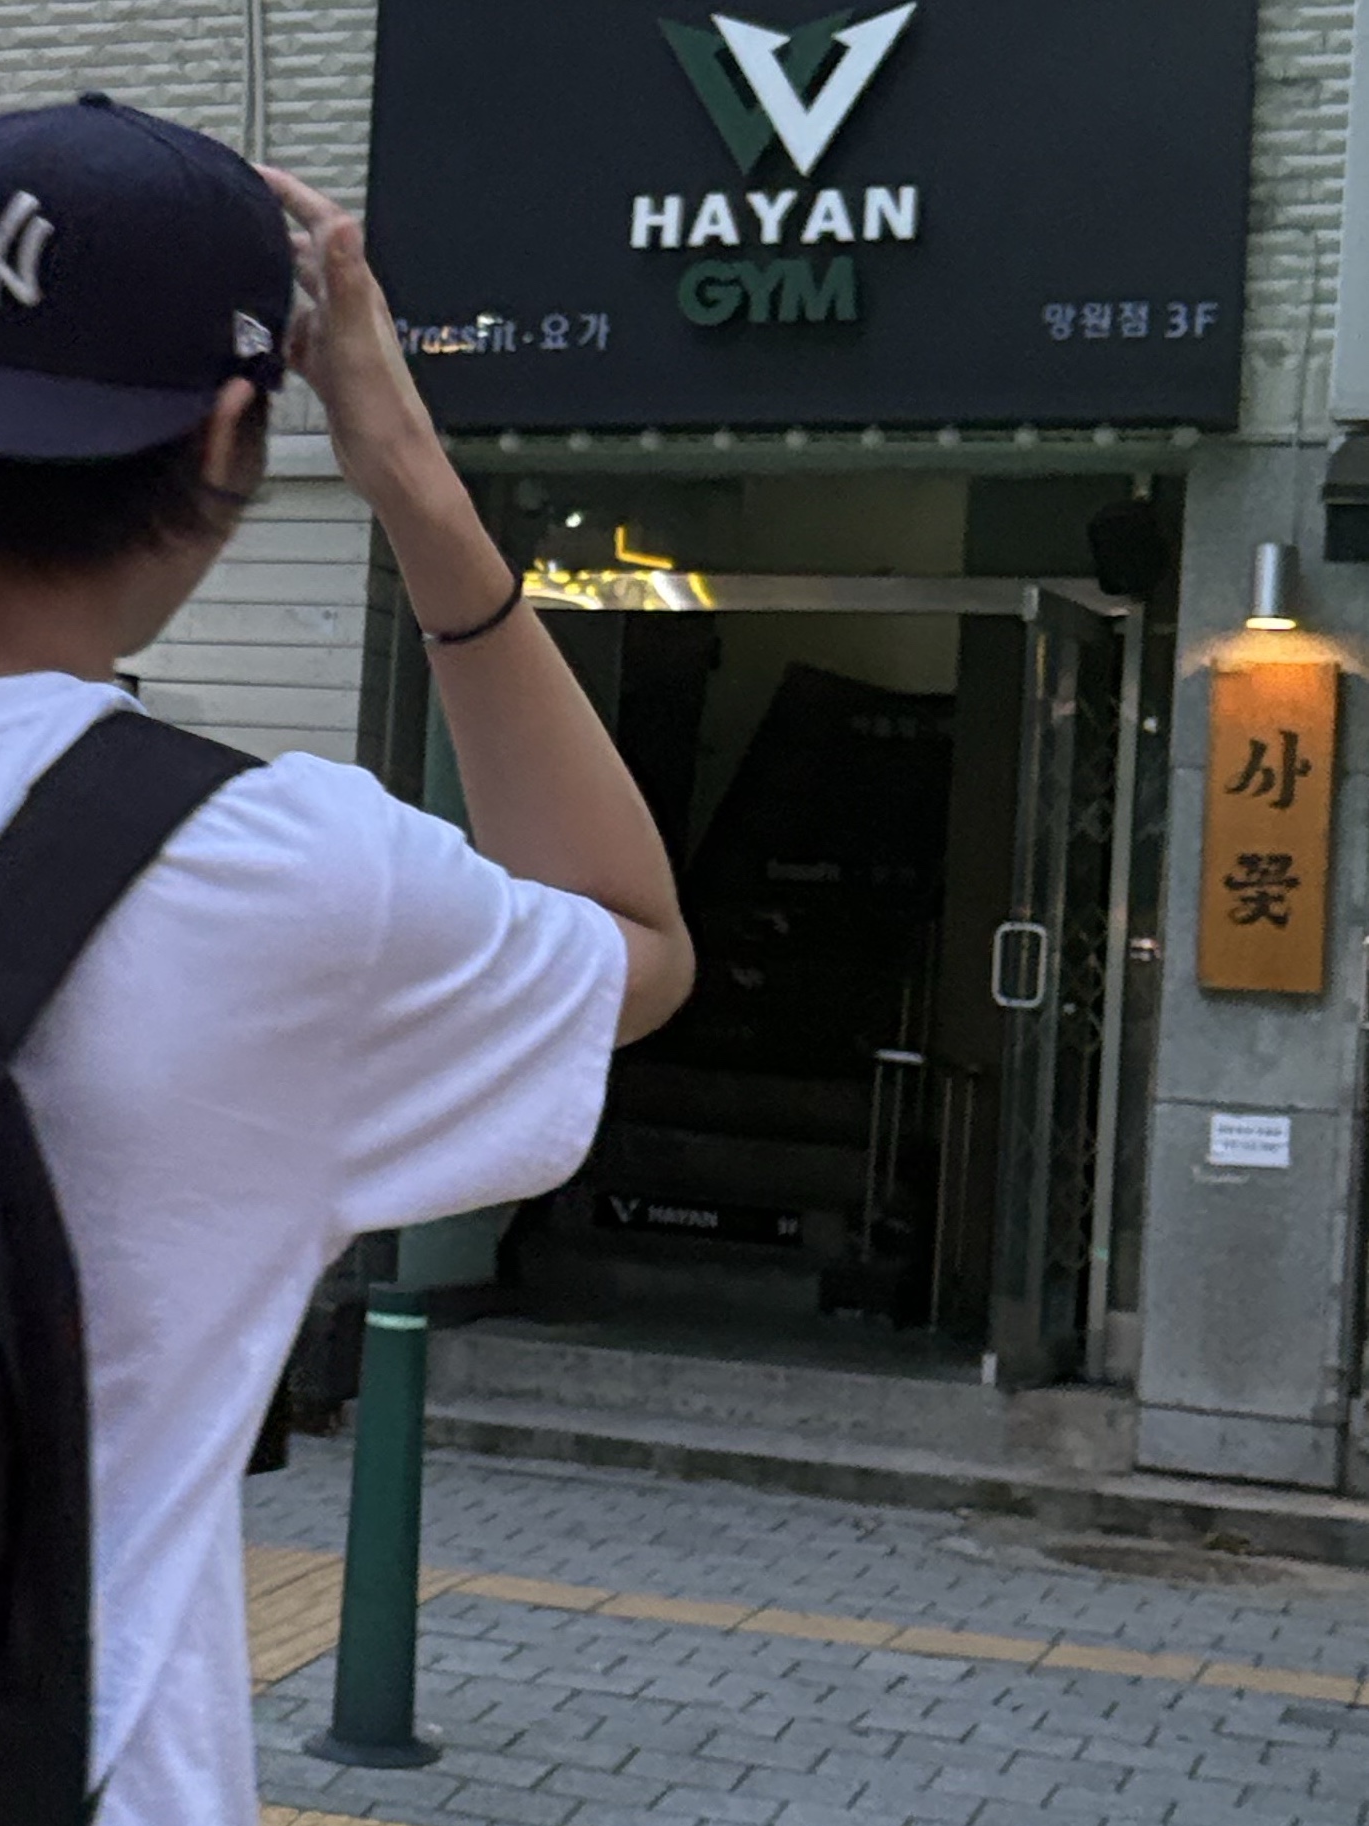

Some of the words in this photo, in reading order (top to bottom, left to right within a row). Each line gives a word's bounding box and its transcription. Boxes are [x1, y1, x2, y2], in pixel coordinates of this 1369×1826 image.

[630, 185, 918, 249] HAYAN
[679, 256, 858, 326] GYM
[1043, 301, 1150, 341] 망원점
[1164, 301, 1221, 339] 3F
